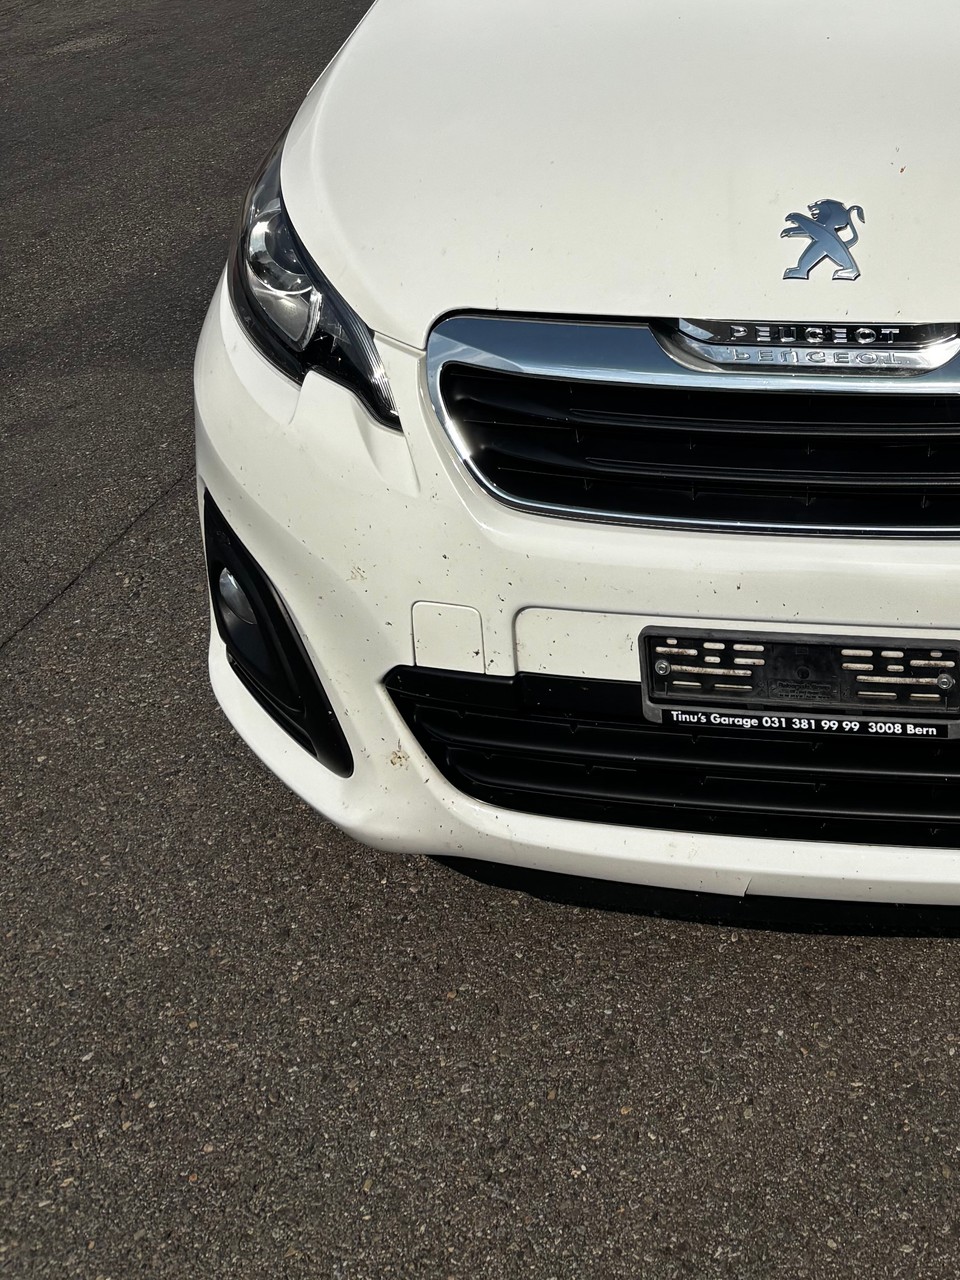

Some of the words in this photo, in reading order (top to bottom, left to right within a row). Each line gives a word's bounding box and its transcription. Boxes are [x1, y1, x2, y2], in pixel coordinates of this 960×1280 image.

[730, 325, 899, 343] PEUGEOT
[671, 711, 707, 723] Tinu's
[710, 713, 759, 728] Garage
[762, 716, 786, 728] 031
[792, 718, 815, 730] 381
[821, 720, 839, 731] 99
[842, 721, 860, 732] 99
[868, 722, 902, 734] 3008
[906, 724, 937, 735] Bern
